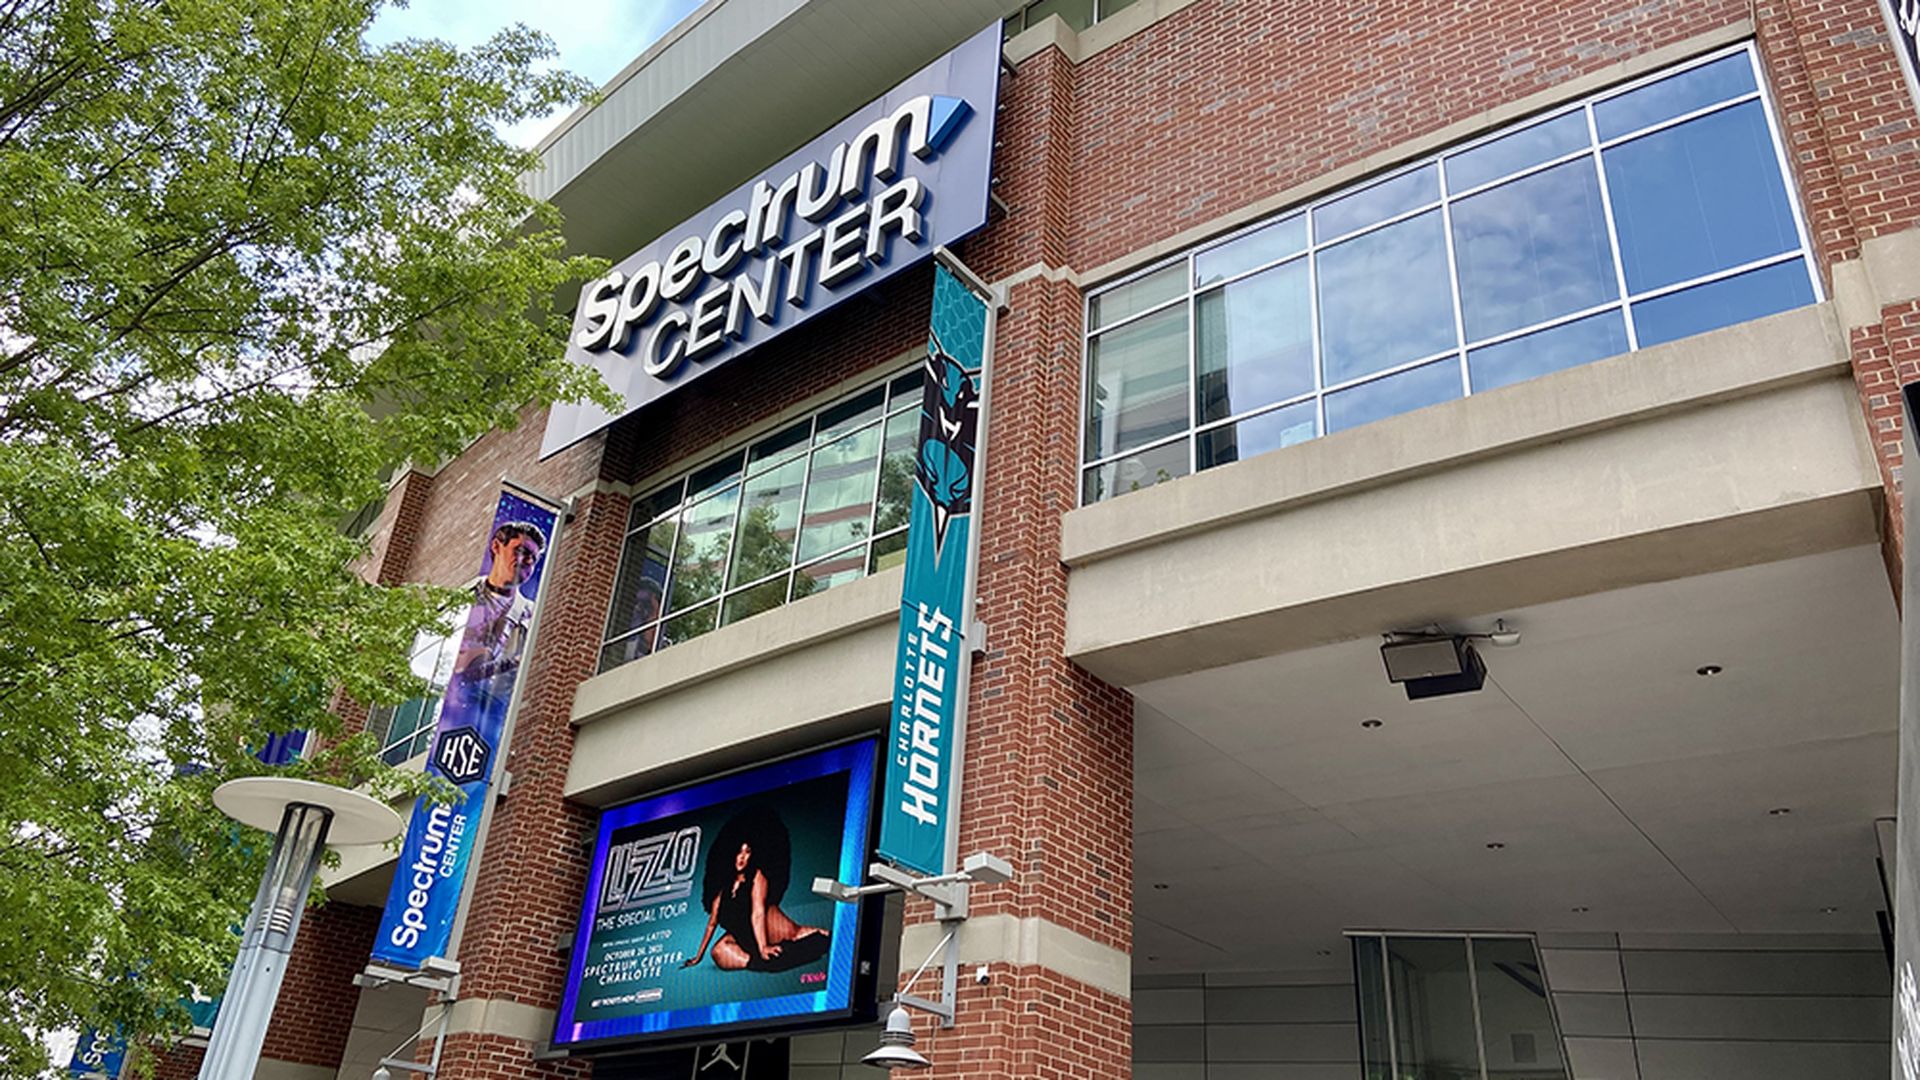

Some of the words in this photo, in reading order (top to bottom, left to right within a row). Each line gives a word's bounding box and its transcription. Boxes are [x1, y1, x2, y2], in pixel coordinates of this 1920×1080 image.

[577, 96, 932, 352] Spectrum
[643, 176, 926, 378] CENTER
[897, 632, 919, 767] CHARLOTTE
[901, 601, 954, 826] HORNETS
[441, 733, 485, 777] HSE
[391, 807, 452, 949] Spectrum
[440, 814, 467, 878] CENTER
[583, 960, 638, 978] SPECTRUM
[641, 951, 683, 968] CENTER
[596, 916, 616, 930] THE
[617, 909, 656, 928] SPECIAL
[659, 902, 688, 919] TOUR
[598, 966, 661, 986] CHARLOTTE
